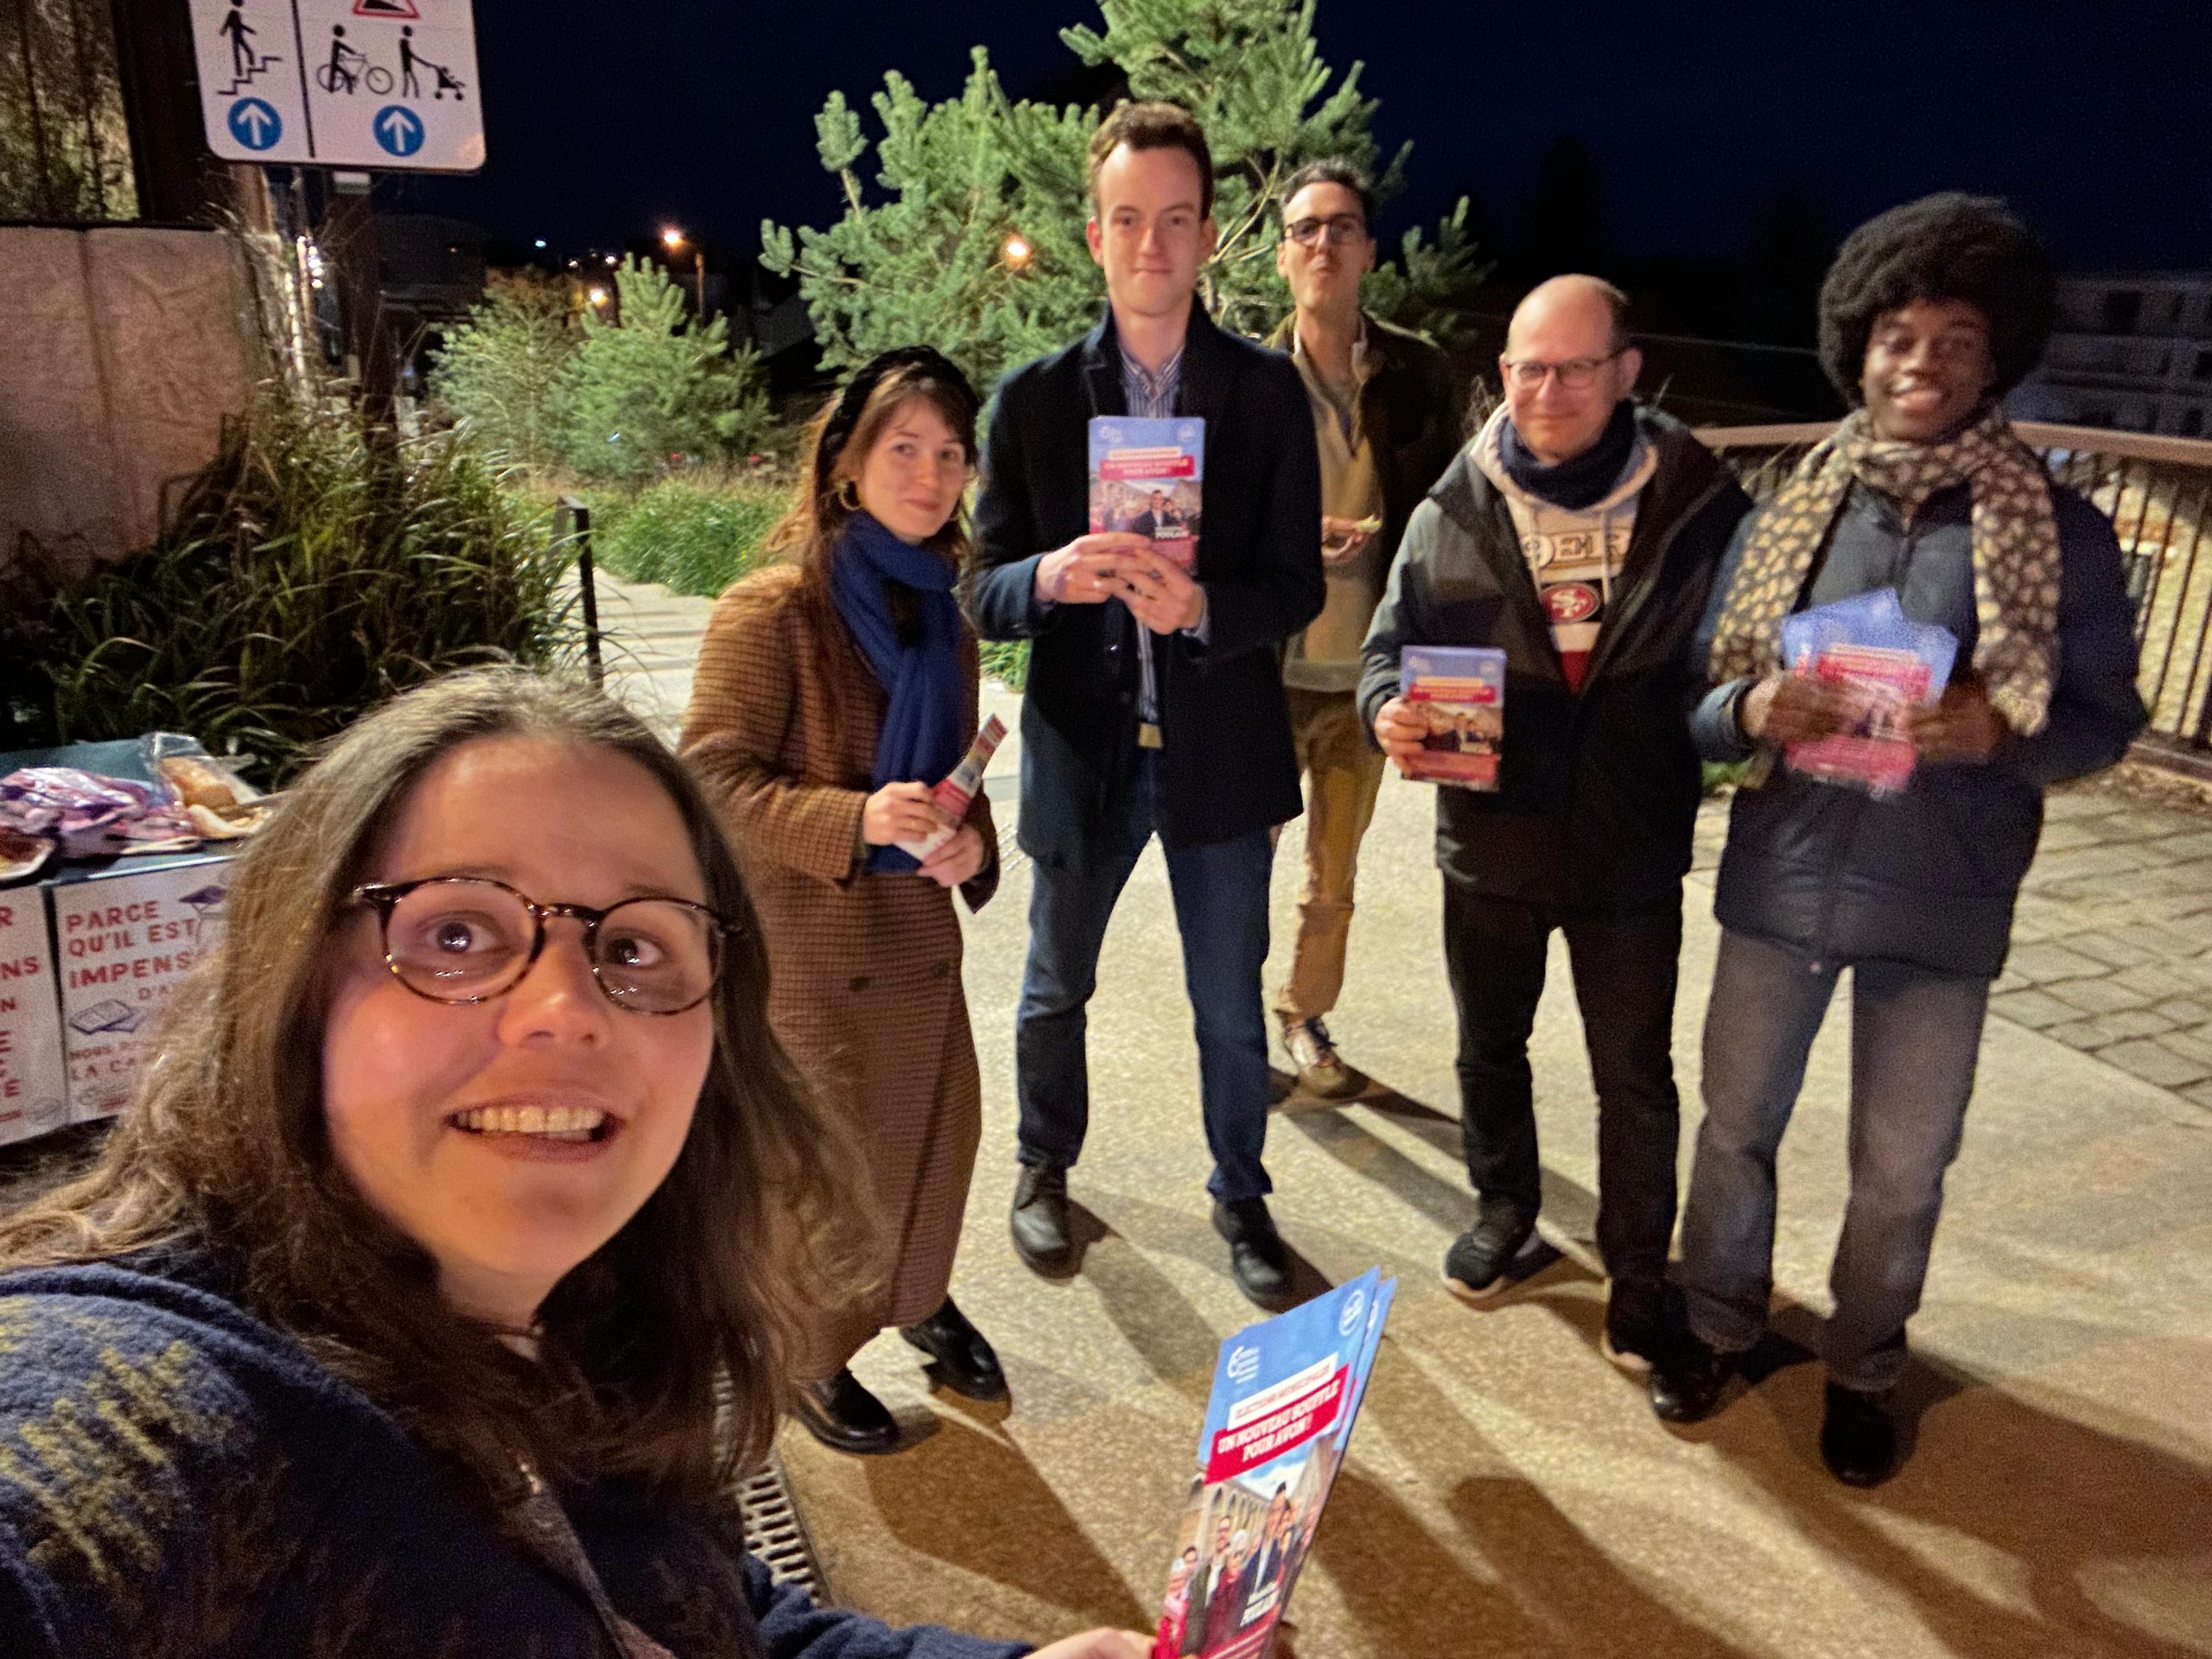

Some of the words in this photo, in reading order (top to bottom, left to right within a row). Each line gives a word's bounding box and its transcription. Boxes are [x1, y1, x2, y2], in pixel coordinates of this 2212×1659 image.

[65, 900, 159, 932] PARCE
[68, 929, 135, 957] QU'IL
[148, 918, 196, 943] EST
